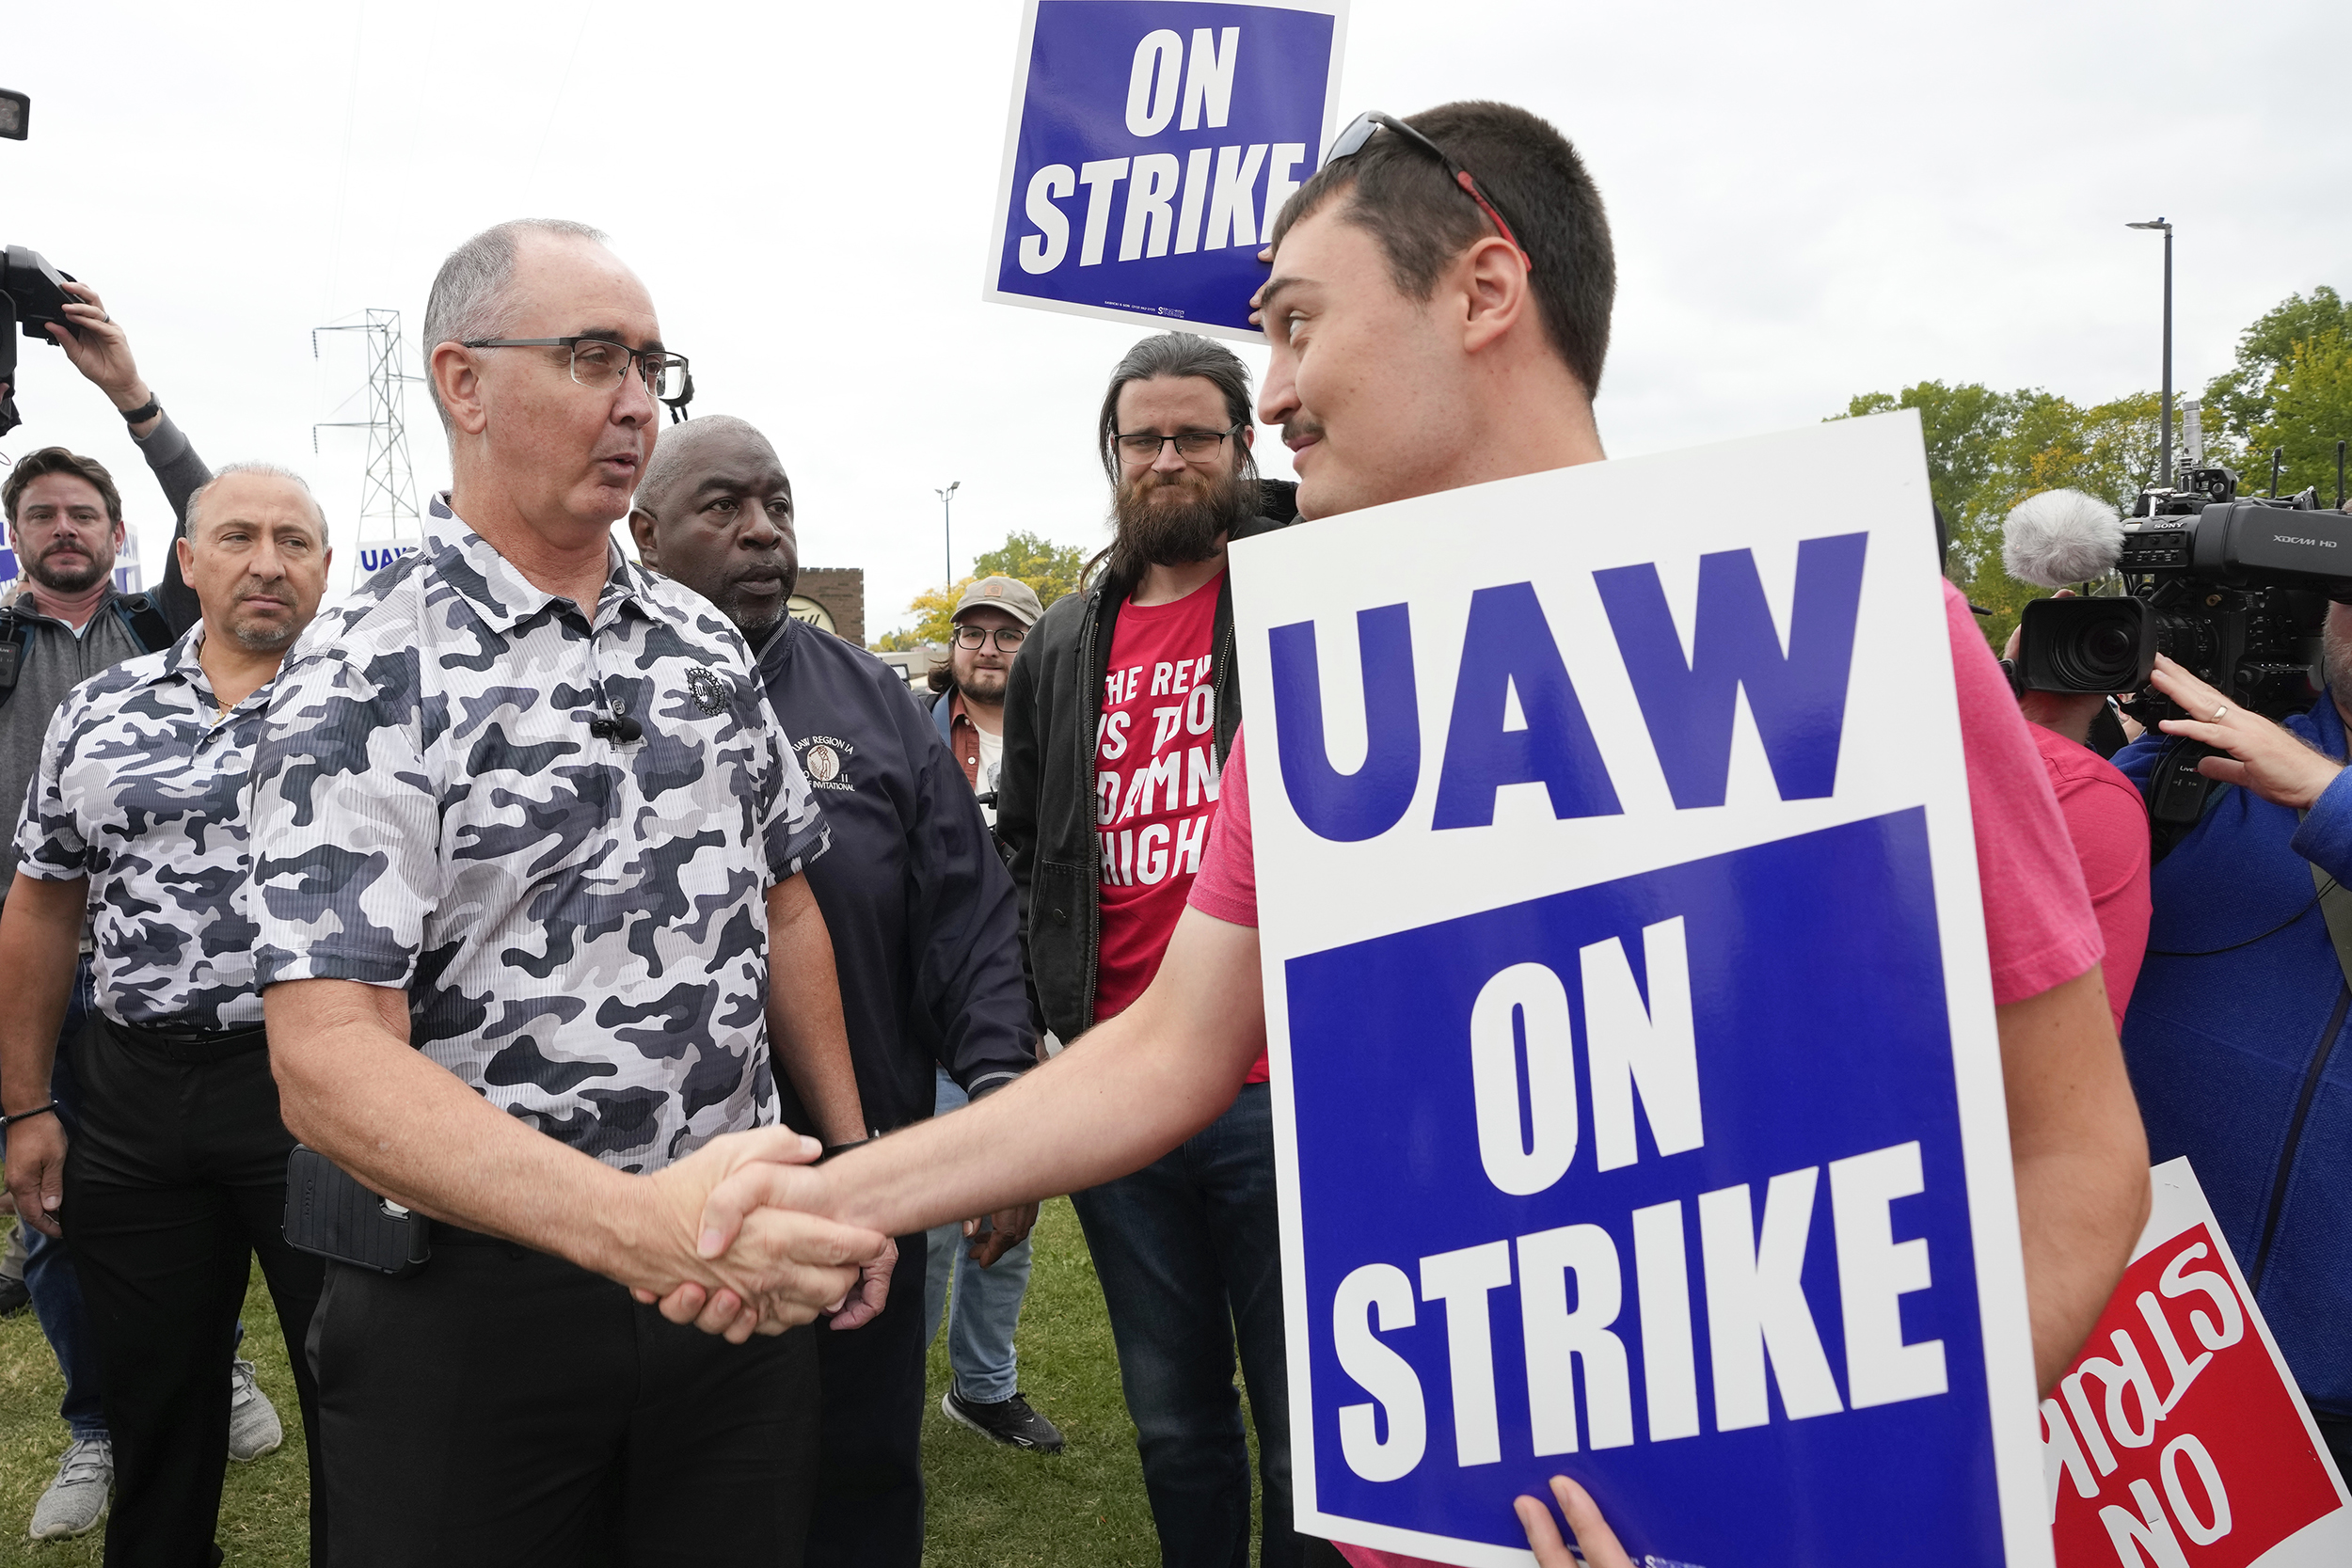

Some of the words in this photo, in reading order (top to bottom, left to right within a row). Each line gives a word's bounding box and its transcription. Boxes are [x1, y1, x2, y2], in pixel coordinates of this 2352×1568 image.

[1124, 26, 1241, 137] ON
[1019, 142, 1306, 275] STRIKE
[2272, 534, 2316, 546] XDCAM
[2319, 540, 2338, 548] HD
[1268, 532, 1868, 843] UAW
[791, 737, 810, 752] UAW
[812, 736, 846, 749] REGION
[812, 781, 856, 792] INVITATIONAL
[1097, 743, 1220, 825] DAMN
[1097, 814, 1209, 886] HIGH
[1470, 914, 1705, 1197] ON
[1332, 1139, 1949, 1483] STRIKE
[2098, 1433, 2233, 1568] ON
